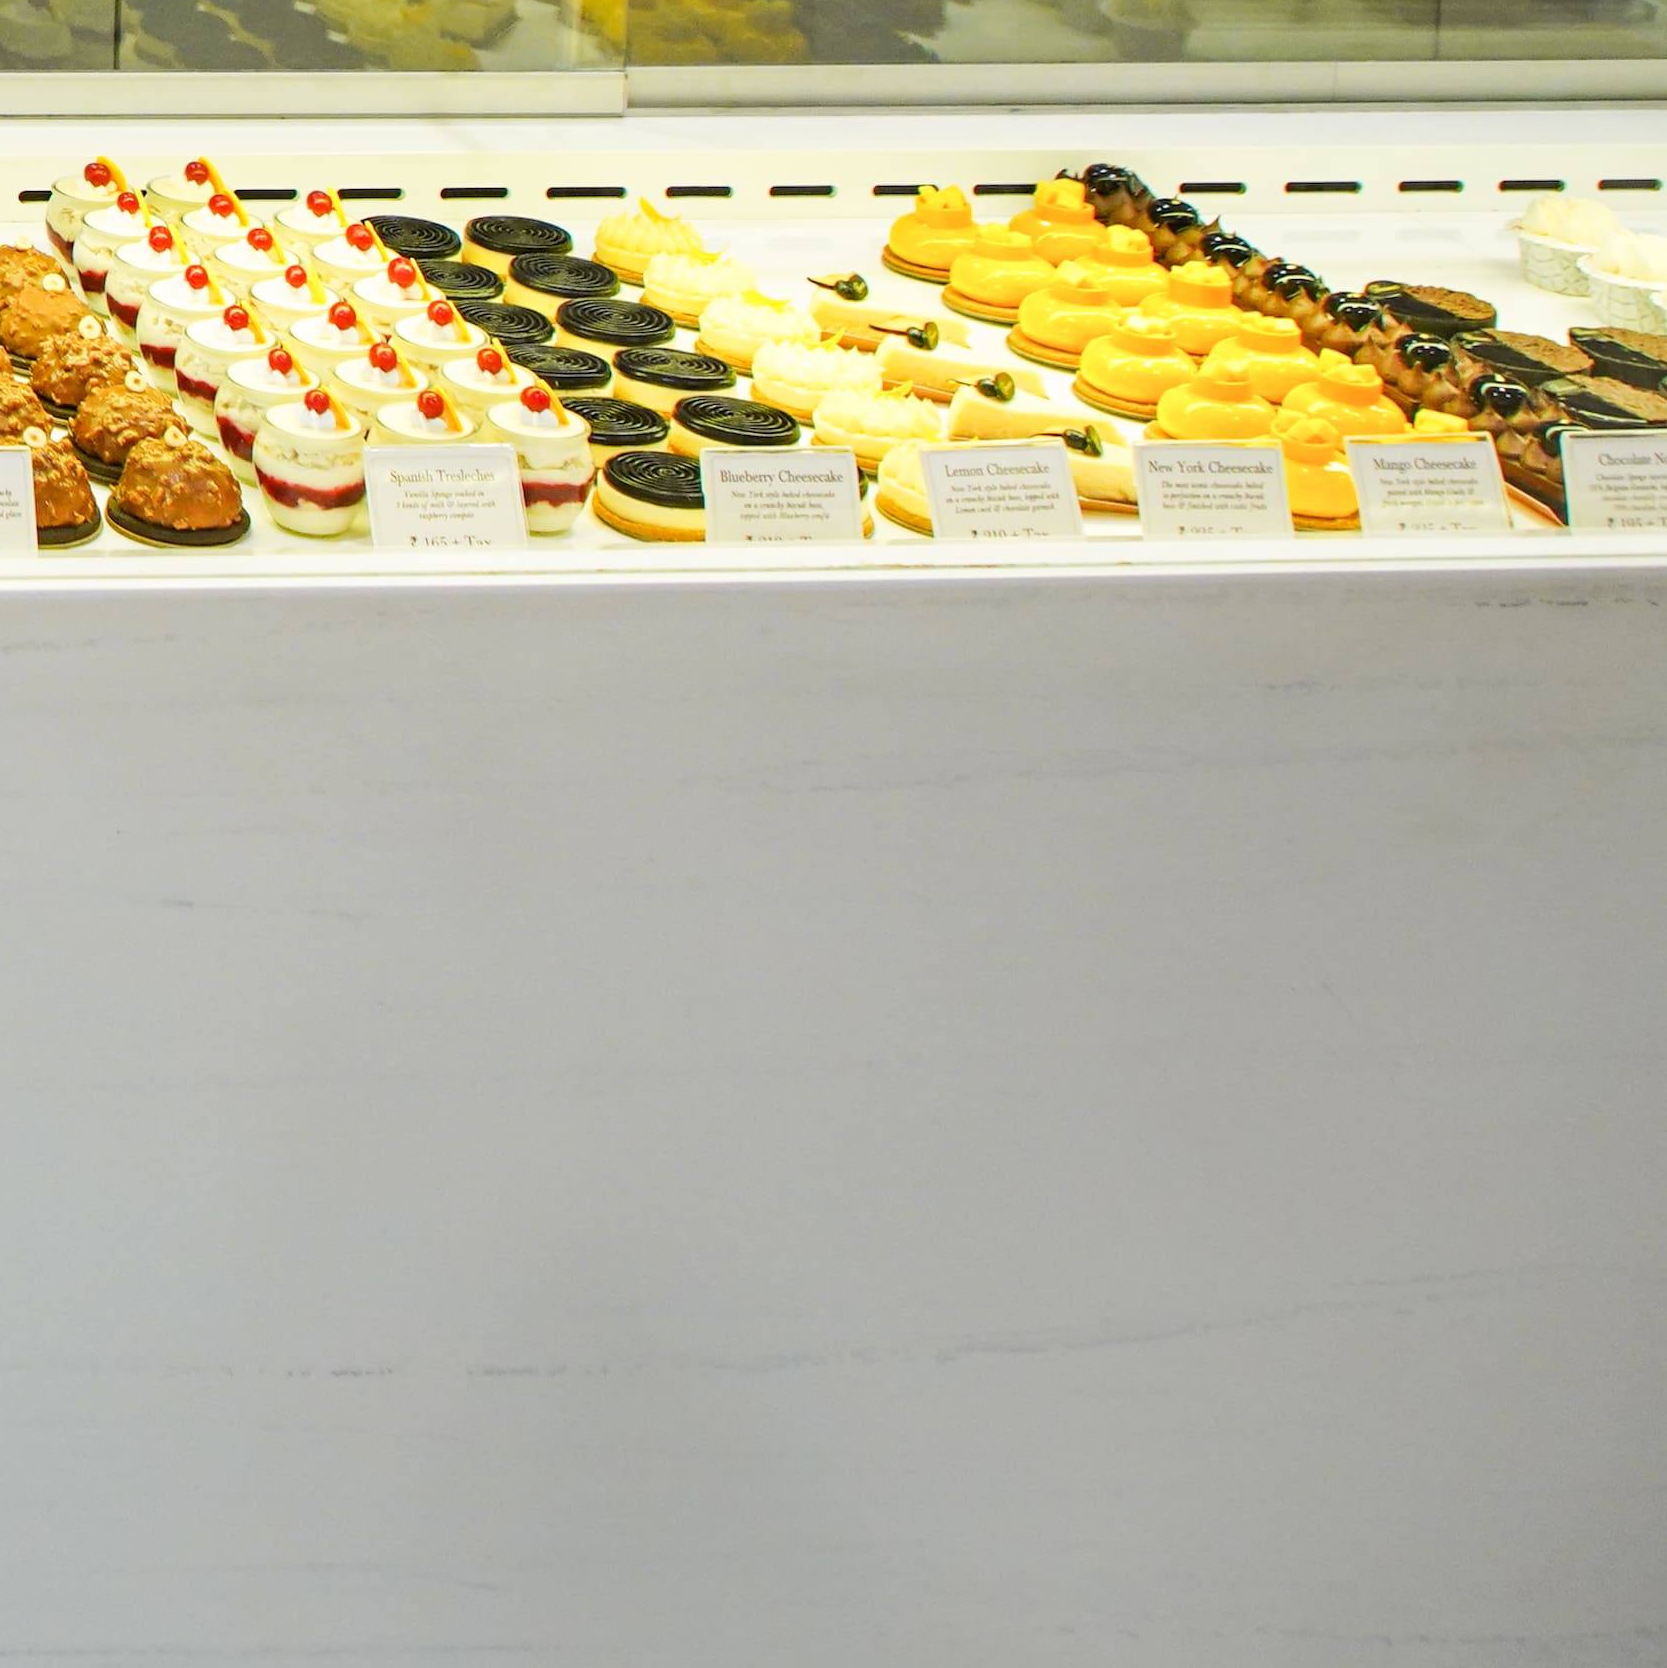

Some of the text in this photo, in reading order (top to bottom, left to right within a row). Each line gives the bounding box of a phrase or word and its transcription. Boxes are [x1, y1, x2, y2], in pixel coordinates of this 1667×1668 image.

[945, 461, 1050, 478] Lemon Cheesecake
[1148, 460, 1273, 474] New York Cheesecake
[1373, 458, 1476, 473] Mango Cheesecake
[390, 469, 433, 487] Spanish
[720, 470, 844, 486] Blueberry Cheesecake
